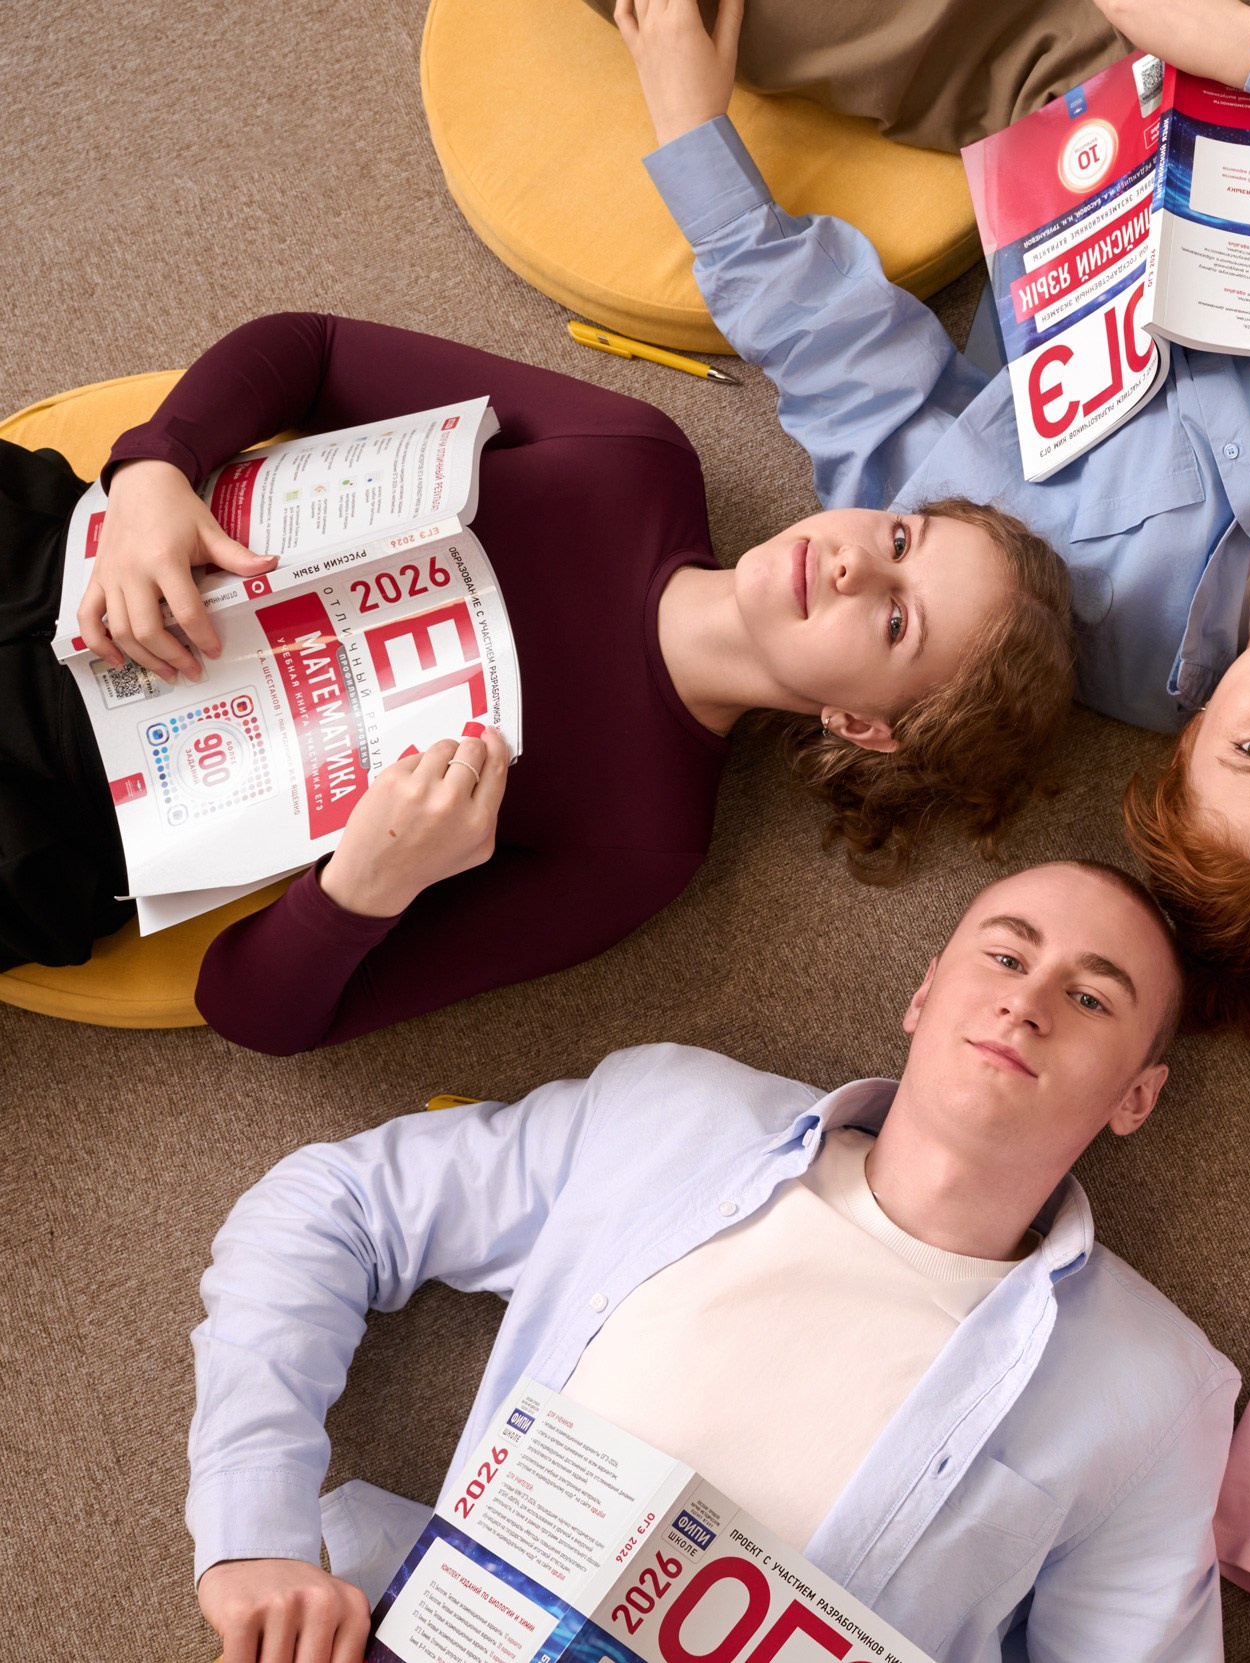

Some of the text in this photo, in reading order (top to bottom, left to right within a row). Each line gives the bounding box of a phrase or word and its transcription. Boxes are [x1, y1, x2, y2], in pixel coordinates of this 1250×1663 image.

[1076, 143, 1100, 171] 10
[1226, 186, 1250, 194] ЯЗЫКУ
[1032, 194, 1133, 261] ЭКЗАМЕНАЦИОННЫЕ ВАРИАНТЫ
[1020, 266, 1071, 313] ЯЗЫК
[1041, 255, 1137, 323] ГОСУДАРСТВЕННЫЙ ЭКЗАМЕН
[1039, 378, 1141, 457] УЧАСТИЕМ РАЗРАБОТЧИКОВ КИМ ОГЭ
[293, 550, 367, 579] РУССКИЙ ЯЗЫК
[390, 527, 440, 548] ЕГЭ 2026
[349, 555, 450, 613] 2026
[448, 546, 481, 607] ОБРАЗОВАНИЕ
[478, 620, 495, 663] УЧАСТИЕМ
[489, 665, 500, 724] РАЗРАБОТЧИКОВ
[262, 666, 280, 710] ШЕСТАКОВ
[322, 586, 384, 778] ОТЛИЧНЫЙ РЕЗУЛ
[363, 597, 488, 760] ЕГ
[276, 637, 322, 810] УЧЕБНАЯ КНИГА УЧАСТНИКА ЕГЭ
[294, 630, 356, 802] МАТЕМАТИКА
[338, 653, 367, 763] ПРОФИЛЬНЫЙ УРОВЕНЬ
[186, 749, 199, 785] ЗАДАНИЙ
[194, 734, 230, 787] 900
[226, 740, 236, 764] БОЛЕЕ
[291, 784, 299, 815] ЯЩЕНКО
[501, 1426, 521, 1443] ШКОЛЕ
[508, 1411, 531, 1432] ФИПИ
[455, 1443, 510, 1520] 2026
[614, 1511, 656, 1563] ОГЭ 2026
[666, 1530, 698, 1557] ШКОЛЕ
[674, 1514, 712, 1546] ФИПИ
[439, 1562, 536, 1633] КОМПЛЕКТ ИЗДАНИЙ ПО БИОЛОГИИ ХИМИИ
[611, 1550, 683, 1635] 2026
[658, 1556, 877, 1663] ОГ
[728, 1528, 886, 1655] ПРОЕКТ С УЧАСТИЕМ РАЗРАБОТЧИКОВ
